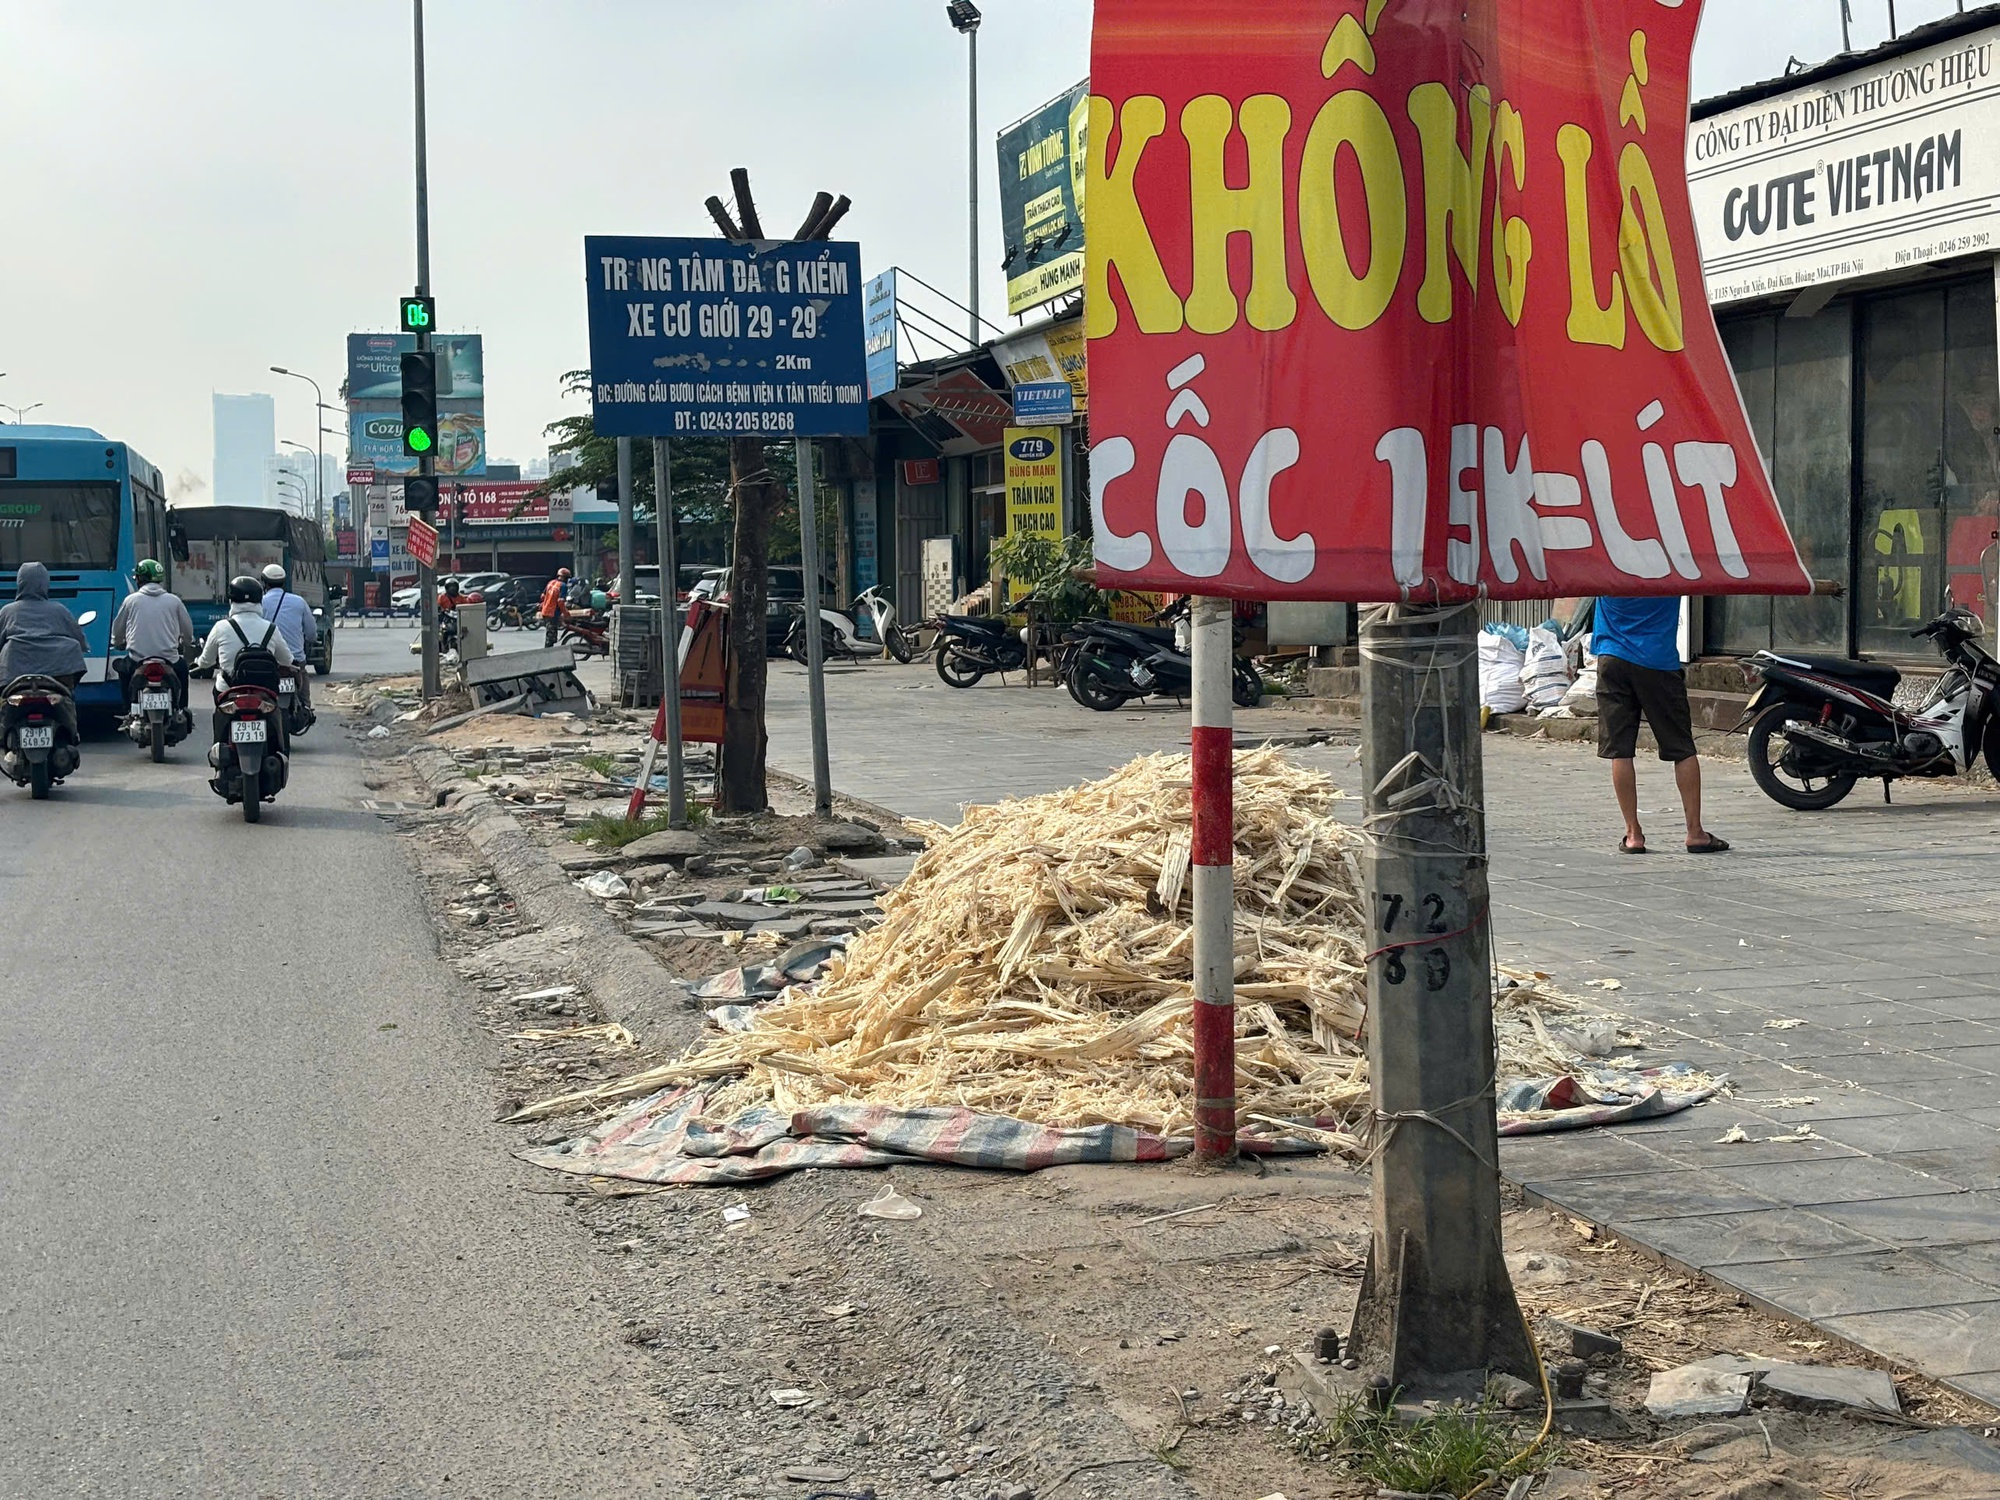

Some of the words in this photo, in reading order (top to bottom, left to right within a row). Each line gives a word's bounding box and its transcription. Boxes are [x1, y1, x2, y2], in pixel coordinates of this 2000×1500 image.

[1695, 121, 1740, 160] CÔNG
[1744, 114, 1765, 146] TY
[1768, 104, 1799, 144] ĐẠI
[1803, 89, 1846, 132] DIỆN
[1850, 61, 1936, 115] THƯƠNG
[1940, 43, 1992, 90] HIỆU
[1826, 127, 1962, 217] VIETNAM
[1051, 193, 1061, 208] CAO
[1912, 243, 1933, 260] Thoại
[1938, 238, 1956, 254] 0246
[1957, 235, 1971, 250] 259
[1972, 231, 1990, 248] 2992
[600, 256, 673, 292] TRNG
[678, 251, 725, 292] TÂM
[732, 252, 791, 294] ĐĂG
[796, 249, 849, 295] KIỂM
[1040, 267, 1060, 291] HÙNG
[1060, 257, 1081, 285] MẠNH
[1795, 269, 1815, 284] Hoàng
[1841, 261, 1851, 275] Hà
[1851, 258, 1864, 274] Nội
[407, 303, 429, 327] 06
[626, 303, 656, 337] XE
[662, 300, 692, 338] CƠ
[698, 297, 740, 338] GIỚI
[747, 305, 773, 338] 29
[791, 305, 818, 339] 29
[370, 362, 401, 373] Ultra
[775, 354, 812, 370] 2Km
[614, 379, 646, 403] ĐƯỜNG
[696, 380, 724, 403] (CÁCH
[726, 380, 750, 406] BỆNH
[752, 380, 775, 406] VIỆN
[776, 384, 784, 403] K
[785, 381, 805, 404] TÂN
[834, 383, 863, 404] 100M)
[1016, 388, 1065, 402] VIETMAP
[368, 422, 404, 436] Cozy
[674, 411, 697, 430] ĐT:
[699, 411, 733, 431] 0243
[734, 411, 759, 431] 205
[761, 411, 795, 431] 8268
[1020, 439, 1043, 453] 779
[1009, 462, 1031, 477] HÙNG
[1032, 463, 1056, 479] MẠNH
[1090, 352, 1317, 584] CỐC
[479, 491, 497, 504] 168
[552, 498, 570, 507] 765
[1012, 480, 1033, 505] TRẦN
[1033, 482, 1055, 504] VÁCH
[1039, 512, 1055, 532] CAO
[403, 557, 415, 571] TỐT
[234, 731, 265, 742] 373.19
